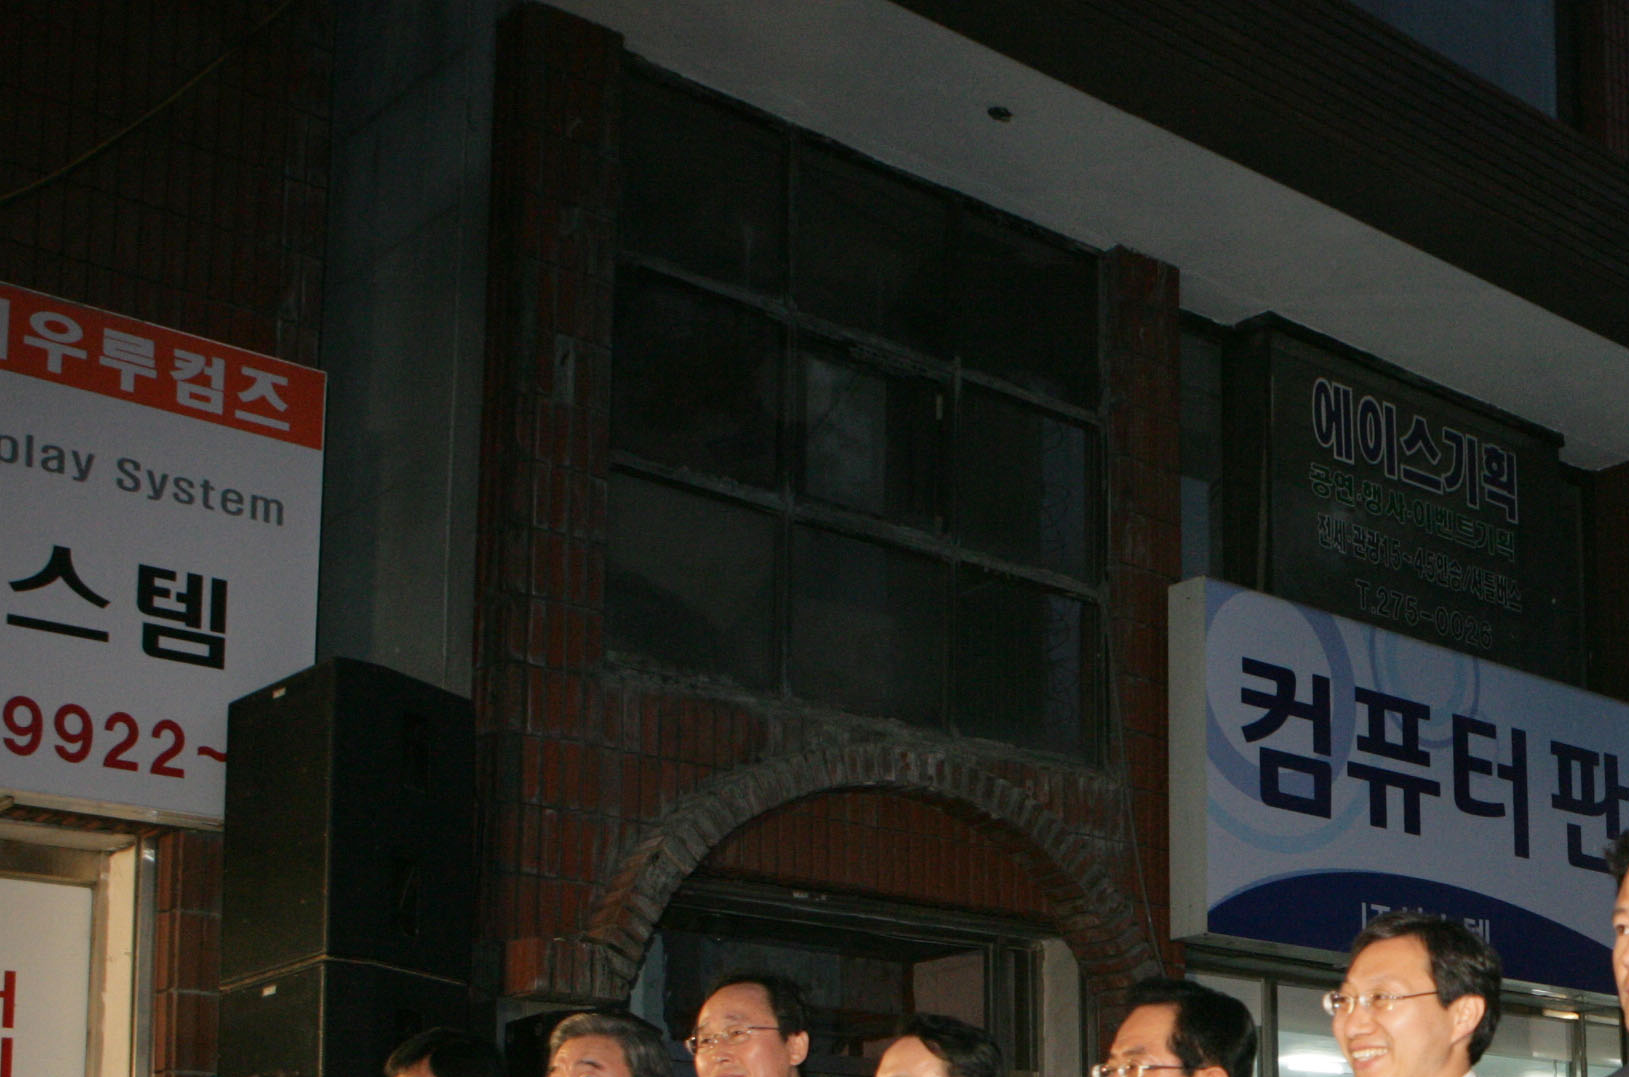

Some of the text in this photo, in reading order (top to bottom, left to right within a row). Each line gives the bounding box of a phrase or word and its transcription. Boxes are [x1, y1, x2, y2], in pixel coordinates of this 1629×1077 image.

[0, 299, 290, 431] 우루컴즈
[116, 458, 285, 526] System
[1311, 377, 1520, 524] 에이스기획
[7, 544, 228, 670] 스템
